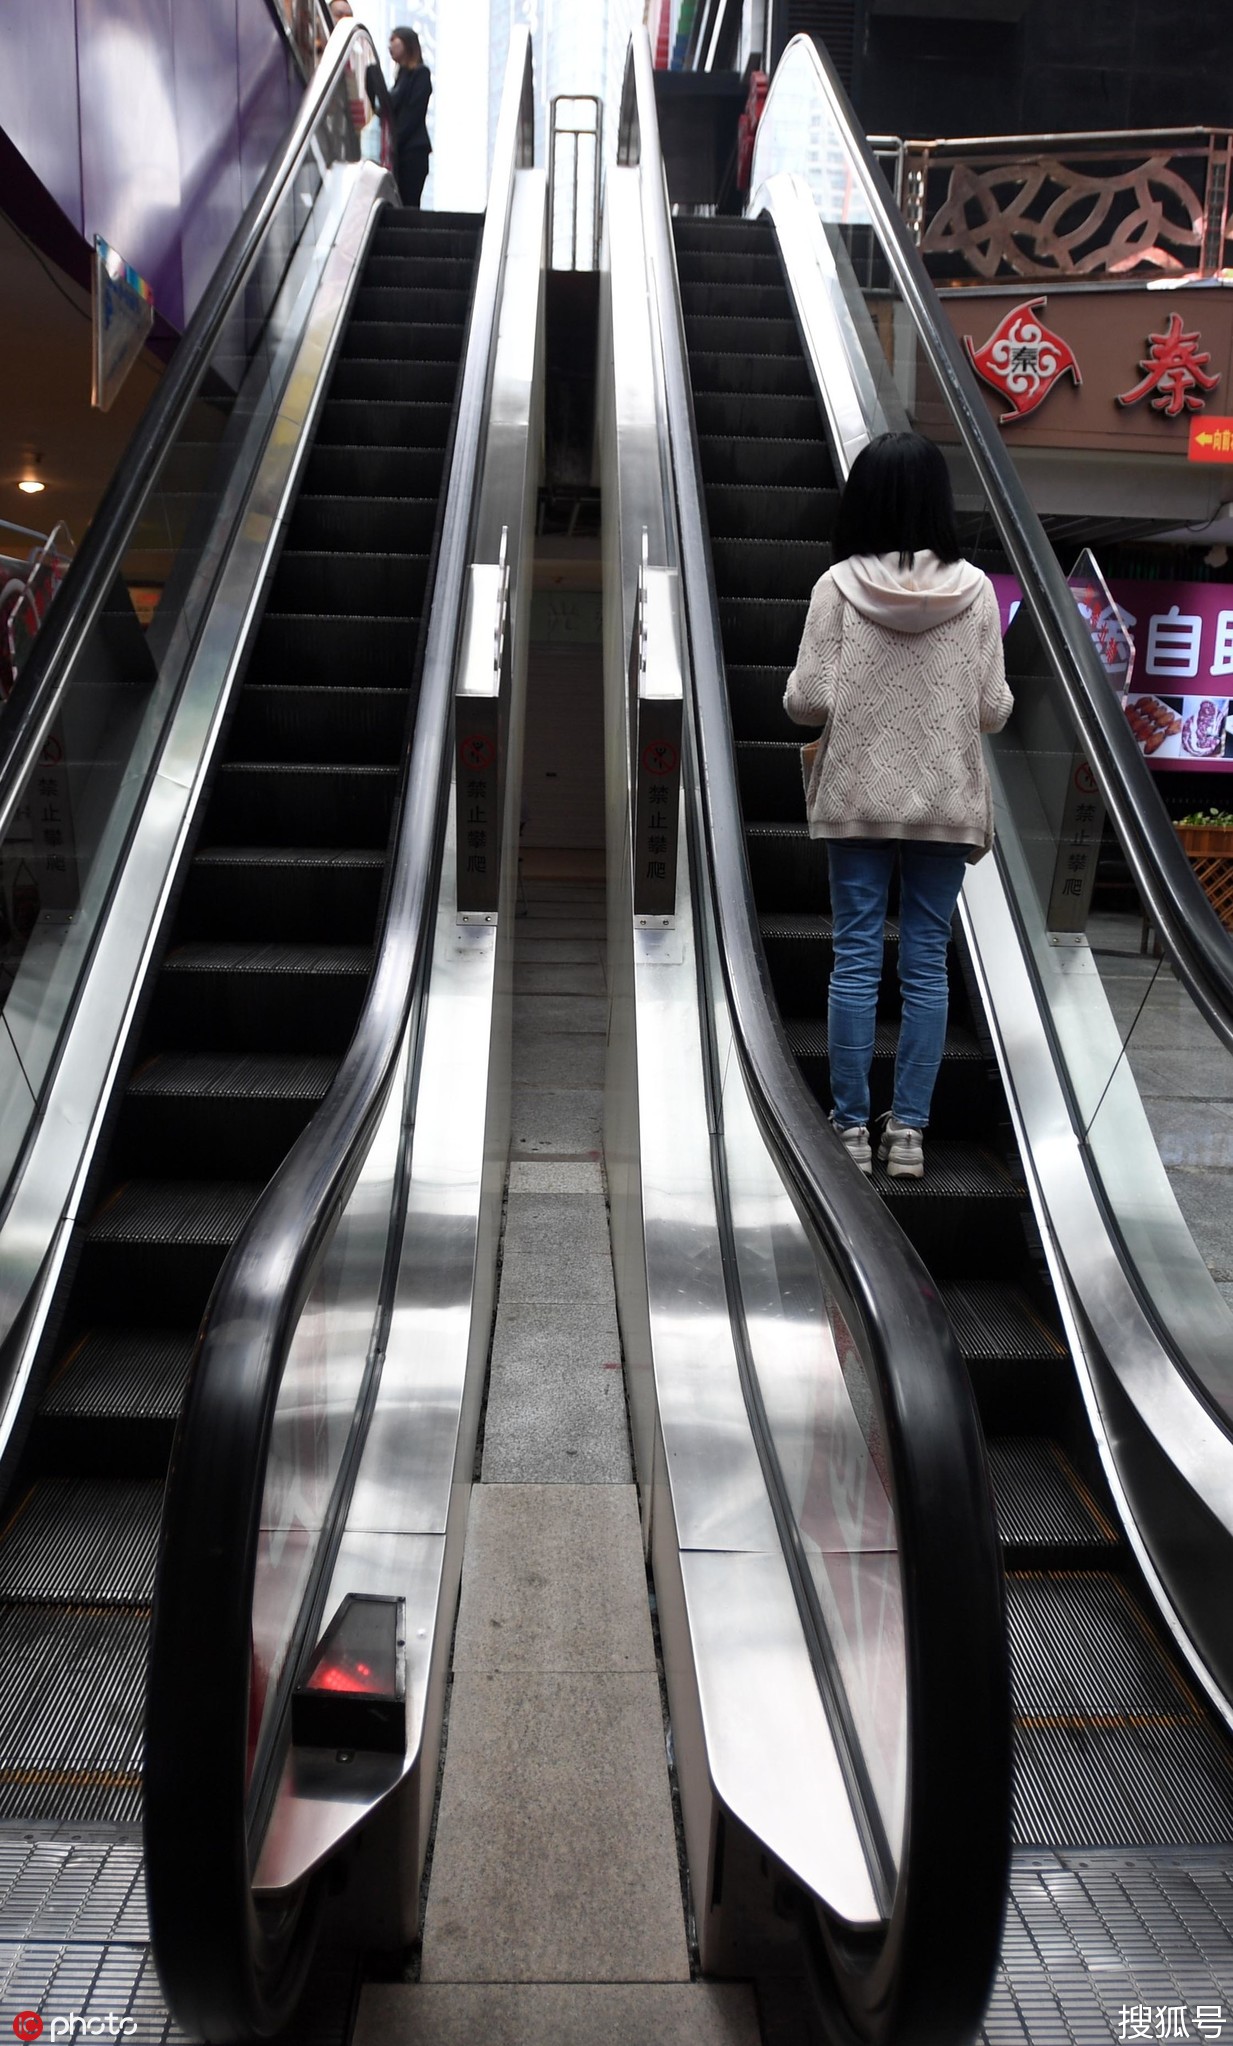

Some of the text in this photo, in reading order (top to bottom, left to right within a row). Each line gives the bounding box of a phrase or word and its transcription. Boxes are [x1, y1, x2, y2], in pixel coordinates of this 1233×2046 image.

[1117, 312, 1222, 416] 秦
[1213, 429, 1233, 451] 向前
[38, 778, 67, 872] 禁止攀爬
[467, 780, 487, 873] 禁止攀爬
[646, 785, 669, 880] 禁止攀爬
[1062, 803, 1095, 896] 禁止攀爬
